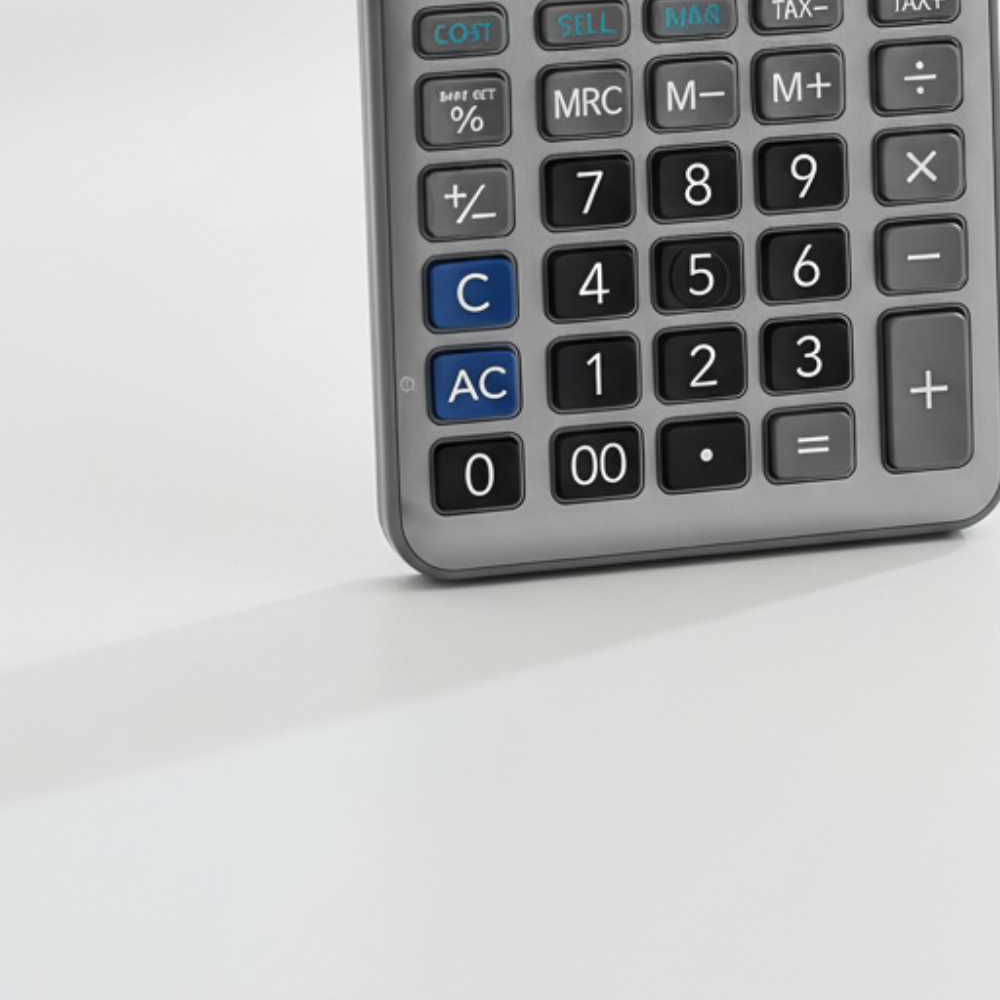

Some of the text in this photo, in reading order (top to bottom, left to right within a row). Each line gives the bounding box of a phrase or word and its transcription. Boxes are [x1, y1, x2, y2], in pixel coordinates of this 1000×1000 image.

[557, 11, 618, 37] SELL
[553, 85, 623, 120] MRC
[666, 80, 725, 112] M-
[772, 71, 832, 104] M+
[450, 105, 485, 134] %
[576, 170, 604, 214] 7
[684, 162, 713, 206] 8
[790, 153, 818, 200] 9
[578, 261, 610, 304] 4
[688, 252, 715, 296] 5
[793, 243, 821, 288] 6
[456, 272, 491, 314] C
[586, 352, 602, 396] 1
[690, 343, 718, 388] 2
[796, 334, 823, 379] 3
[448, 366, 508, 404] AC
[464, 452, 496, 497] 0
[571, 442, 628, 486] 00
